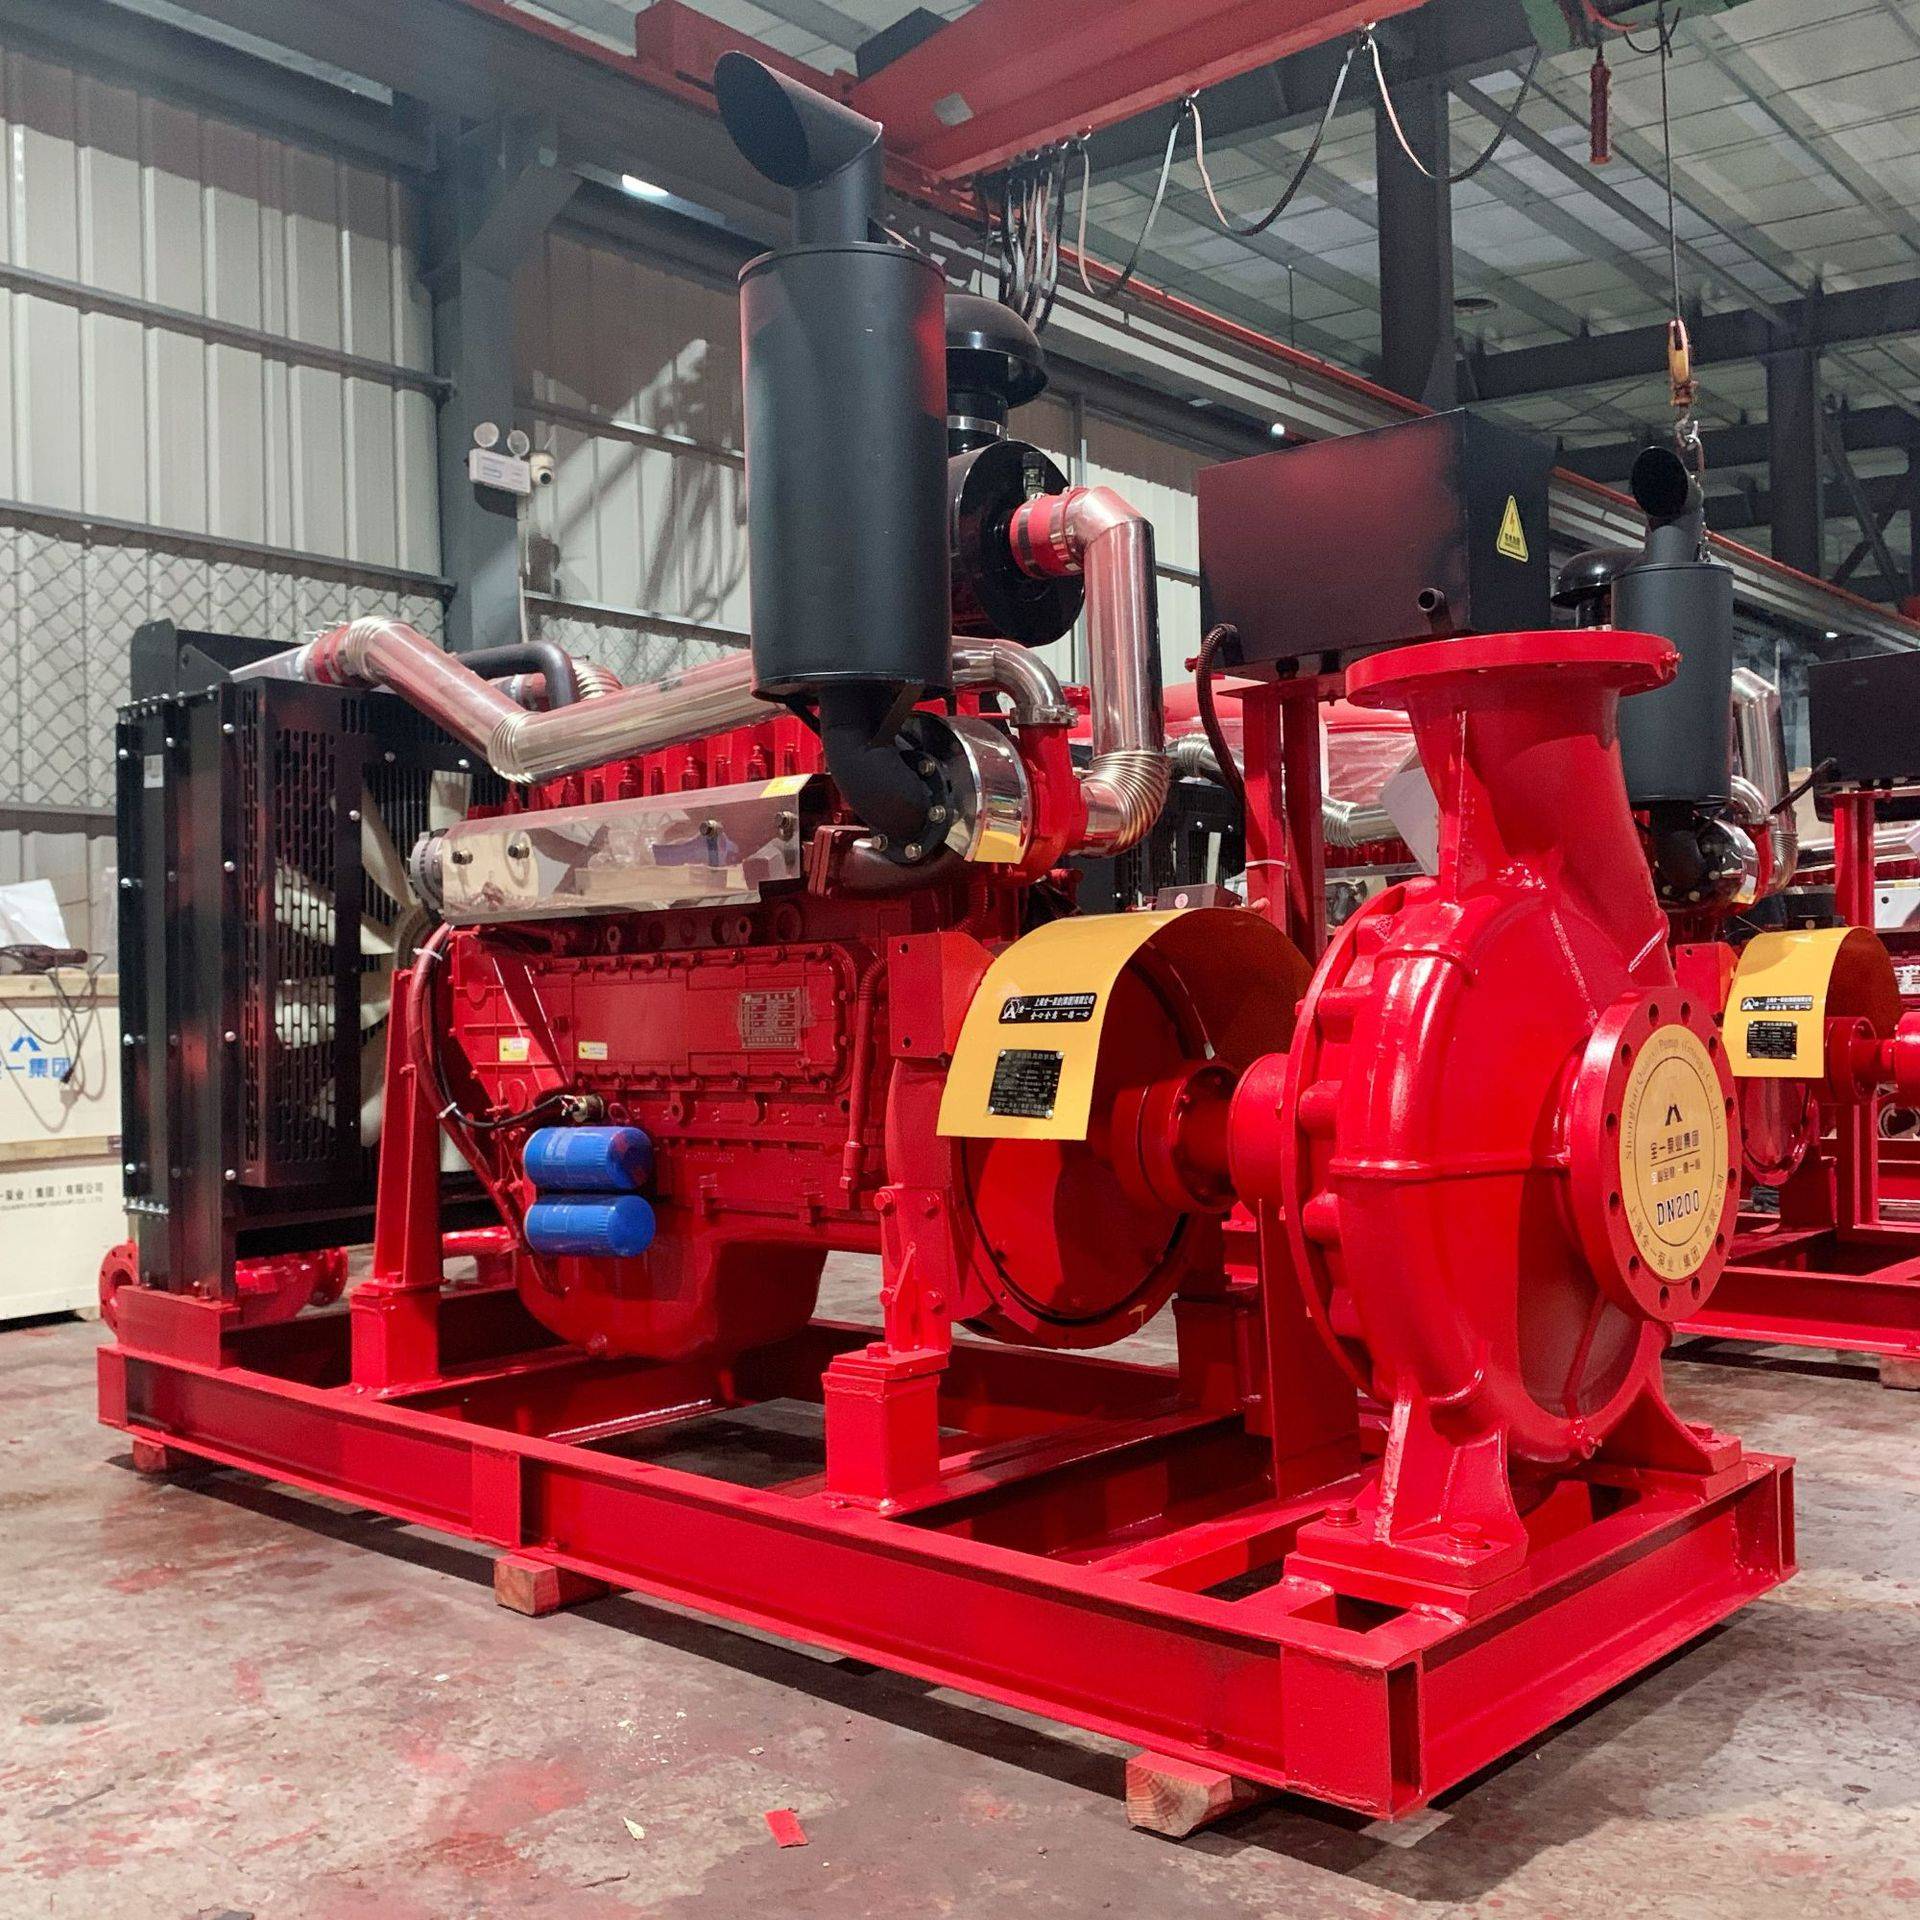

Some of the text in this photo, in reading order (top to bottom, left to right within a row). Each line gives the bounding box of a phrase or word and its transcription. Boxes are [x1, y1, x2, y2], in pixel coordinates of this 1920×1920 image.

[0, 1057, 72, 1079] 一集团
[1656, 1189, 1700, 1226] DN200
